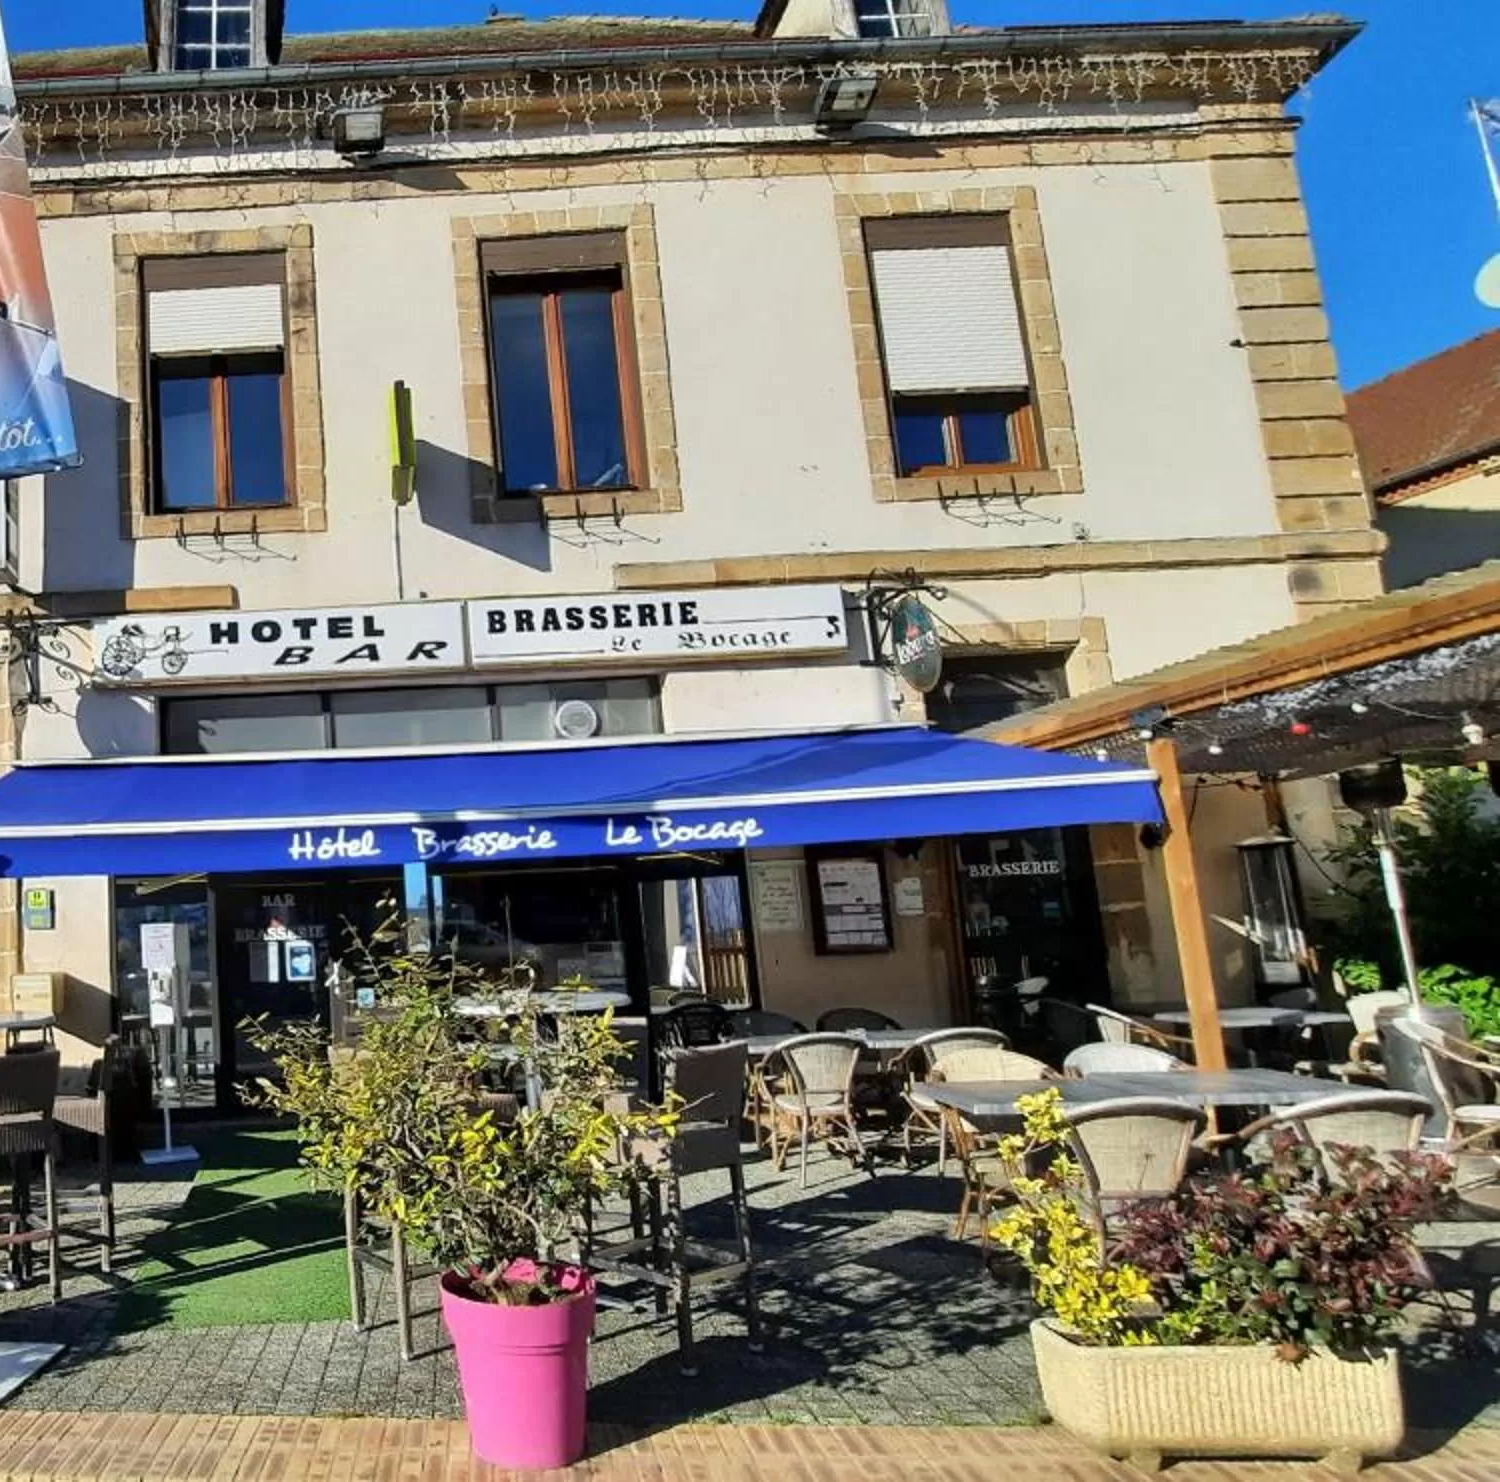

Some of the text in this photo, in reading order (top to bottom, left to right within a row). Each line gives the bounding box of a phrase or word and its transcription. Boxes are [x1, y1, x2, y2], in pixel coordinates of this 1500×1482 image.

[209, 615, 386, 645] HOTEL
[486, 600, 700, 635] BRASSERIE
[272, 640, 449, 666] BAR
[610, 630, 793, 653] Le Bocage
[288, 814, 765, 861] Hôtel Brasserie Le Bocage
[967, 859, 1061, 878] BRASSERIE
